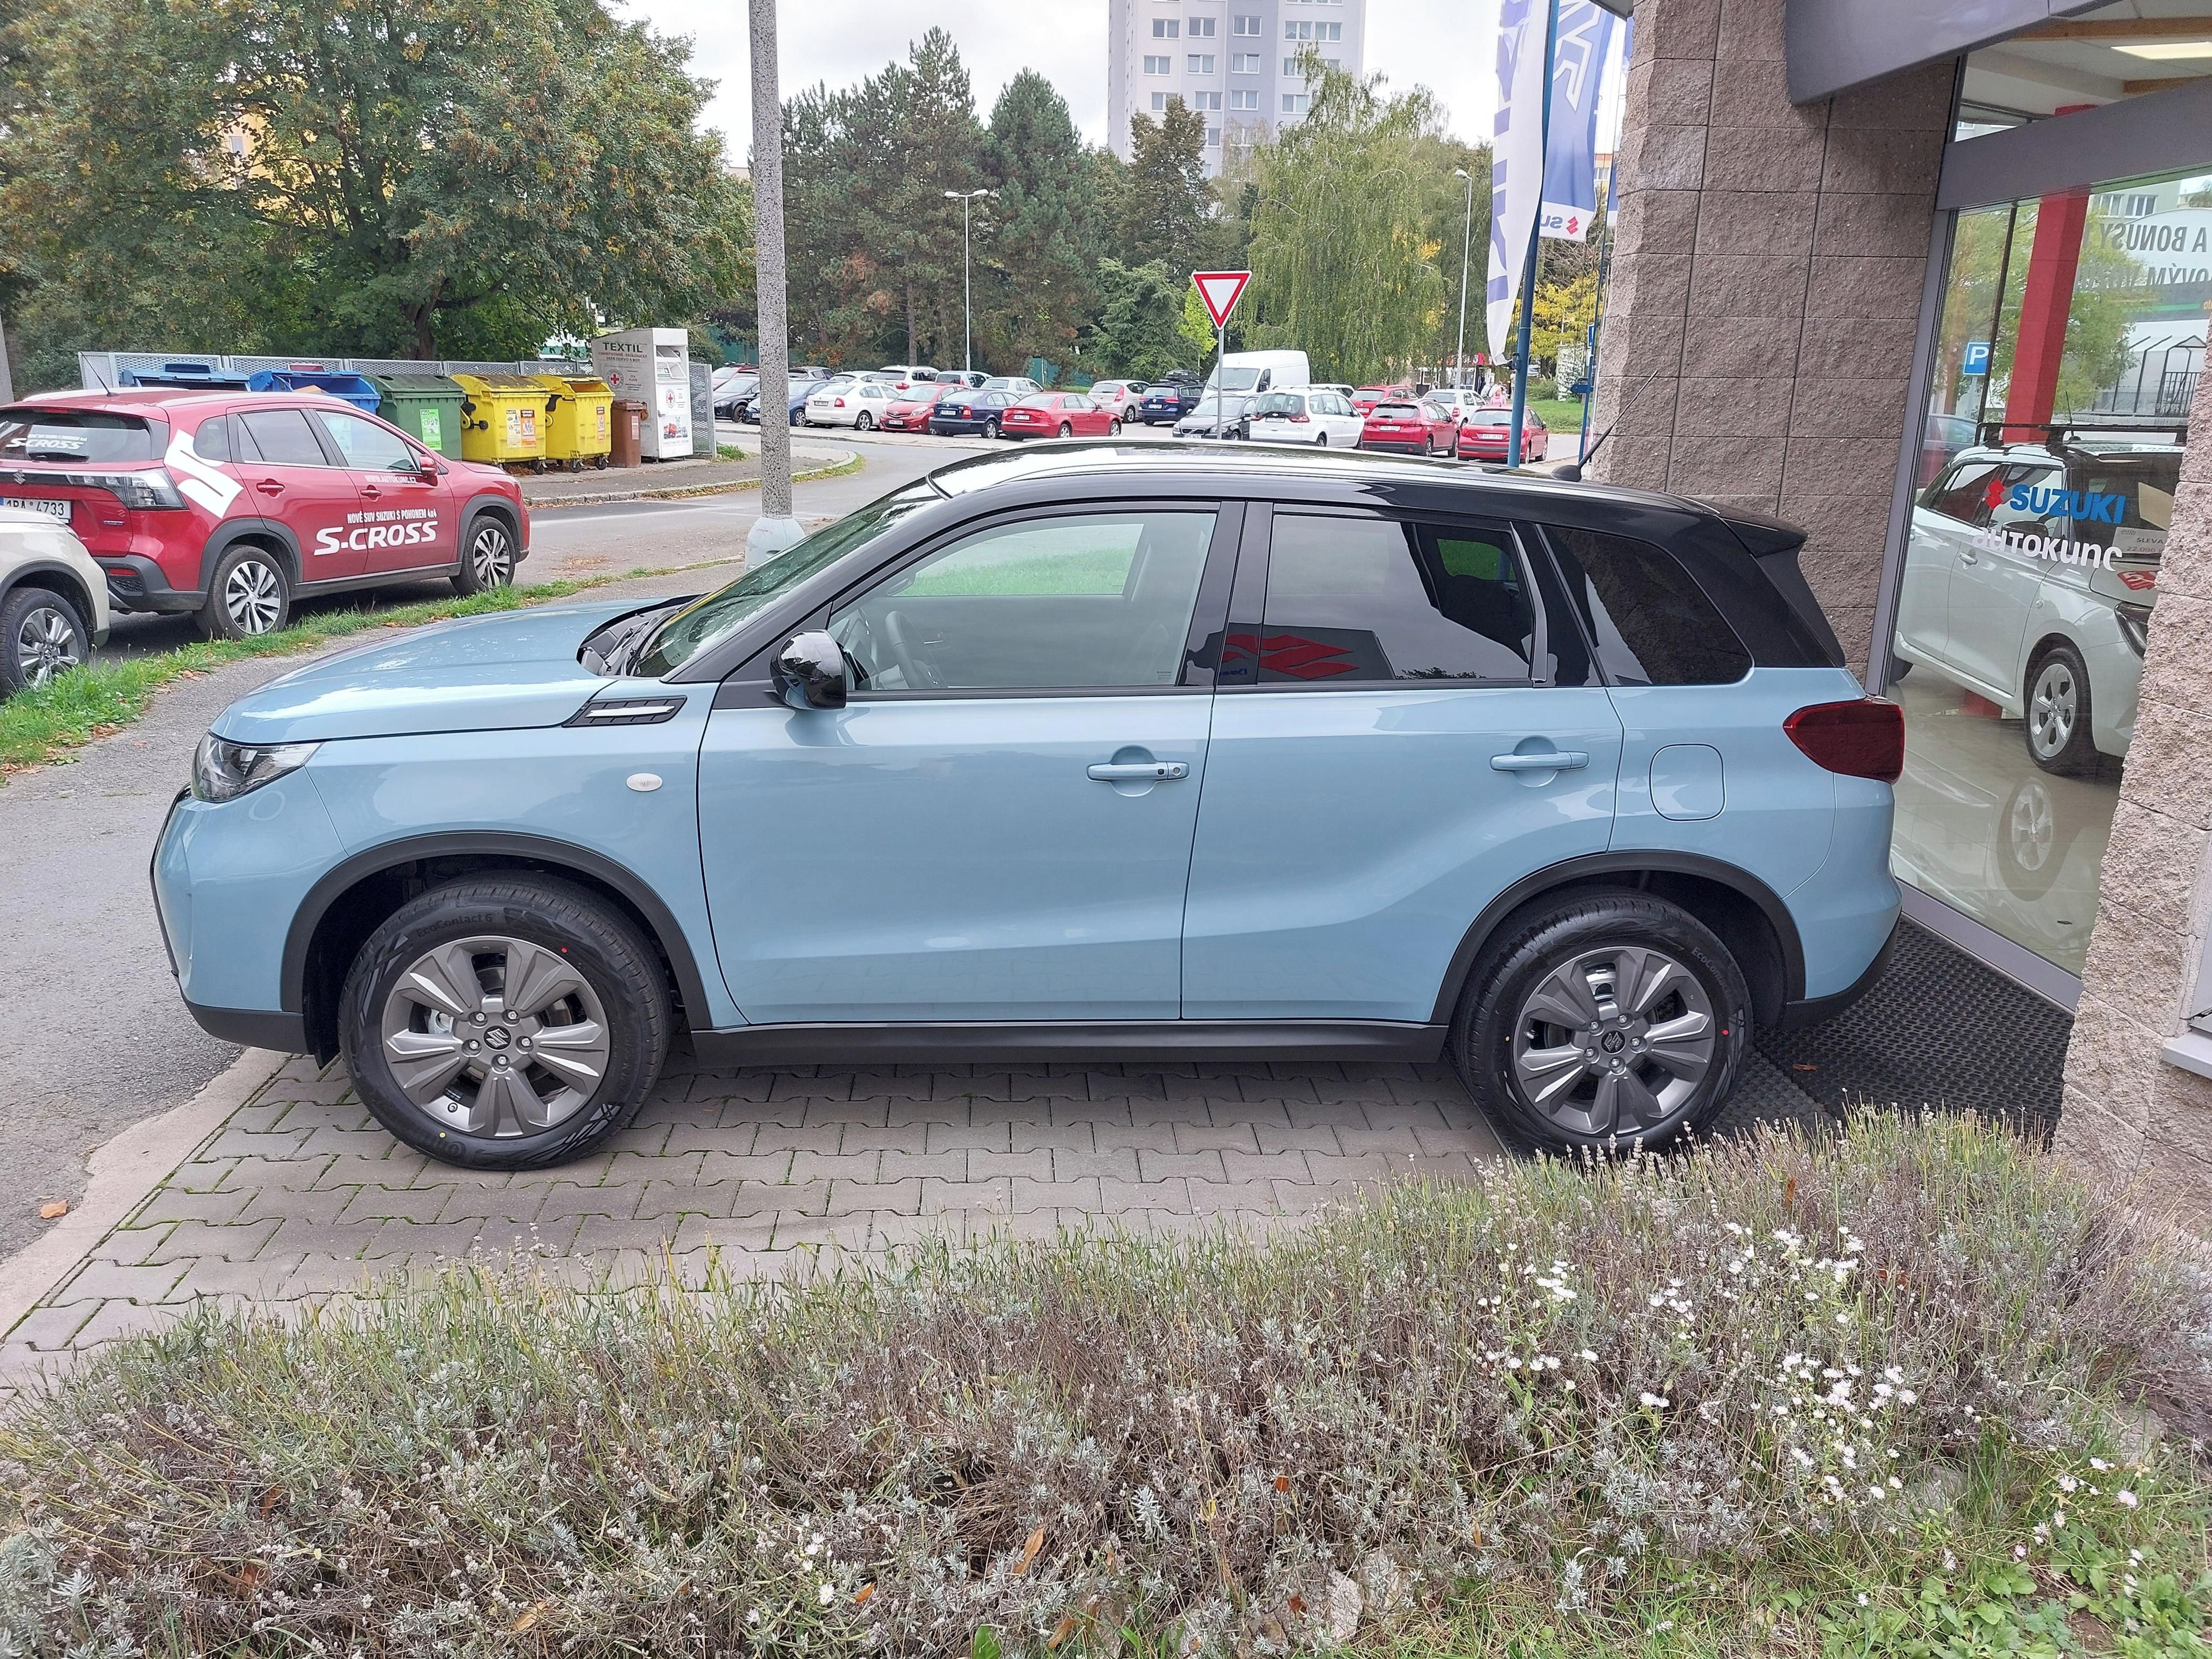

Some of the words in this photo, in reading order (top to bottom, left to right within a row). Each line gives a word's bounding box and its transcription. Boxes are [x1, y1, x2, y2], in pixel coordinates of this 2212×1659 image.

[602, 342, 643, 353] TEXTIL
[36, 502, 64, 516] 4733
[2010, 484, 2127, 524] SUZUKI
[347, 511, 363, 524] NOVÉ
[363, 511, 375, 523] SUV
[376, 509, 396, 522] SUZUKI
[396, 509, 401, 521] S
[401, 508, 427, 522] POHONEM
[427, 508, 437, 519] 4x4
